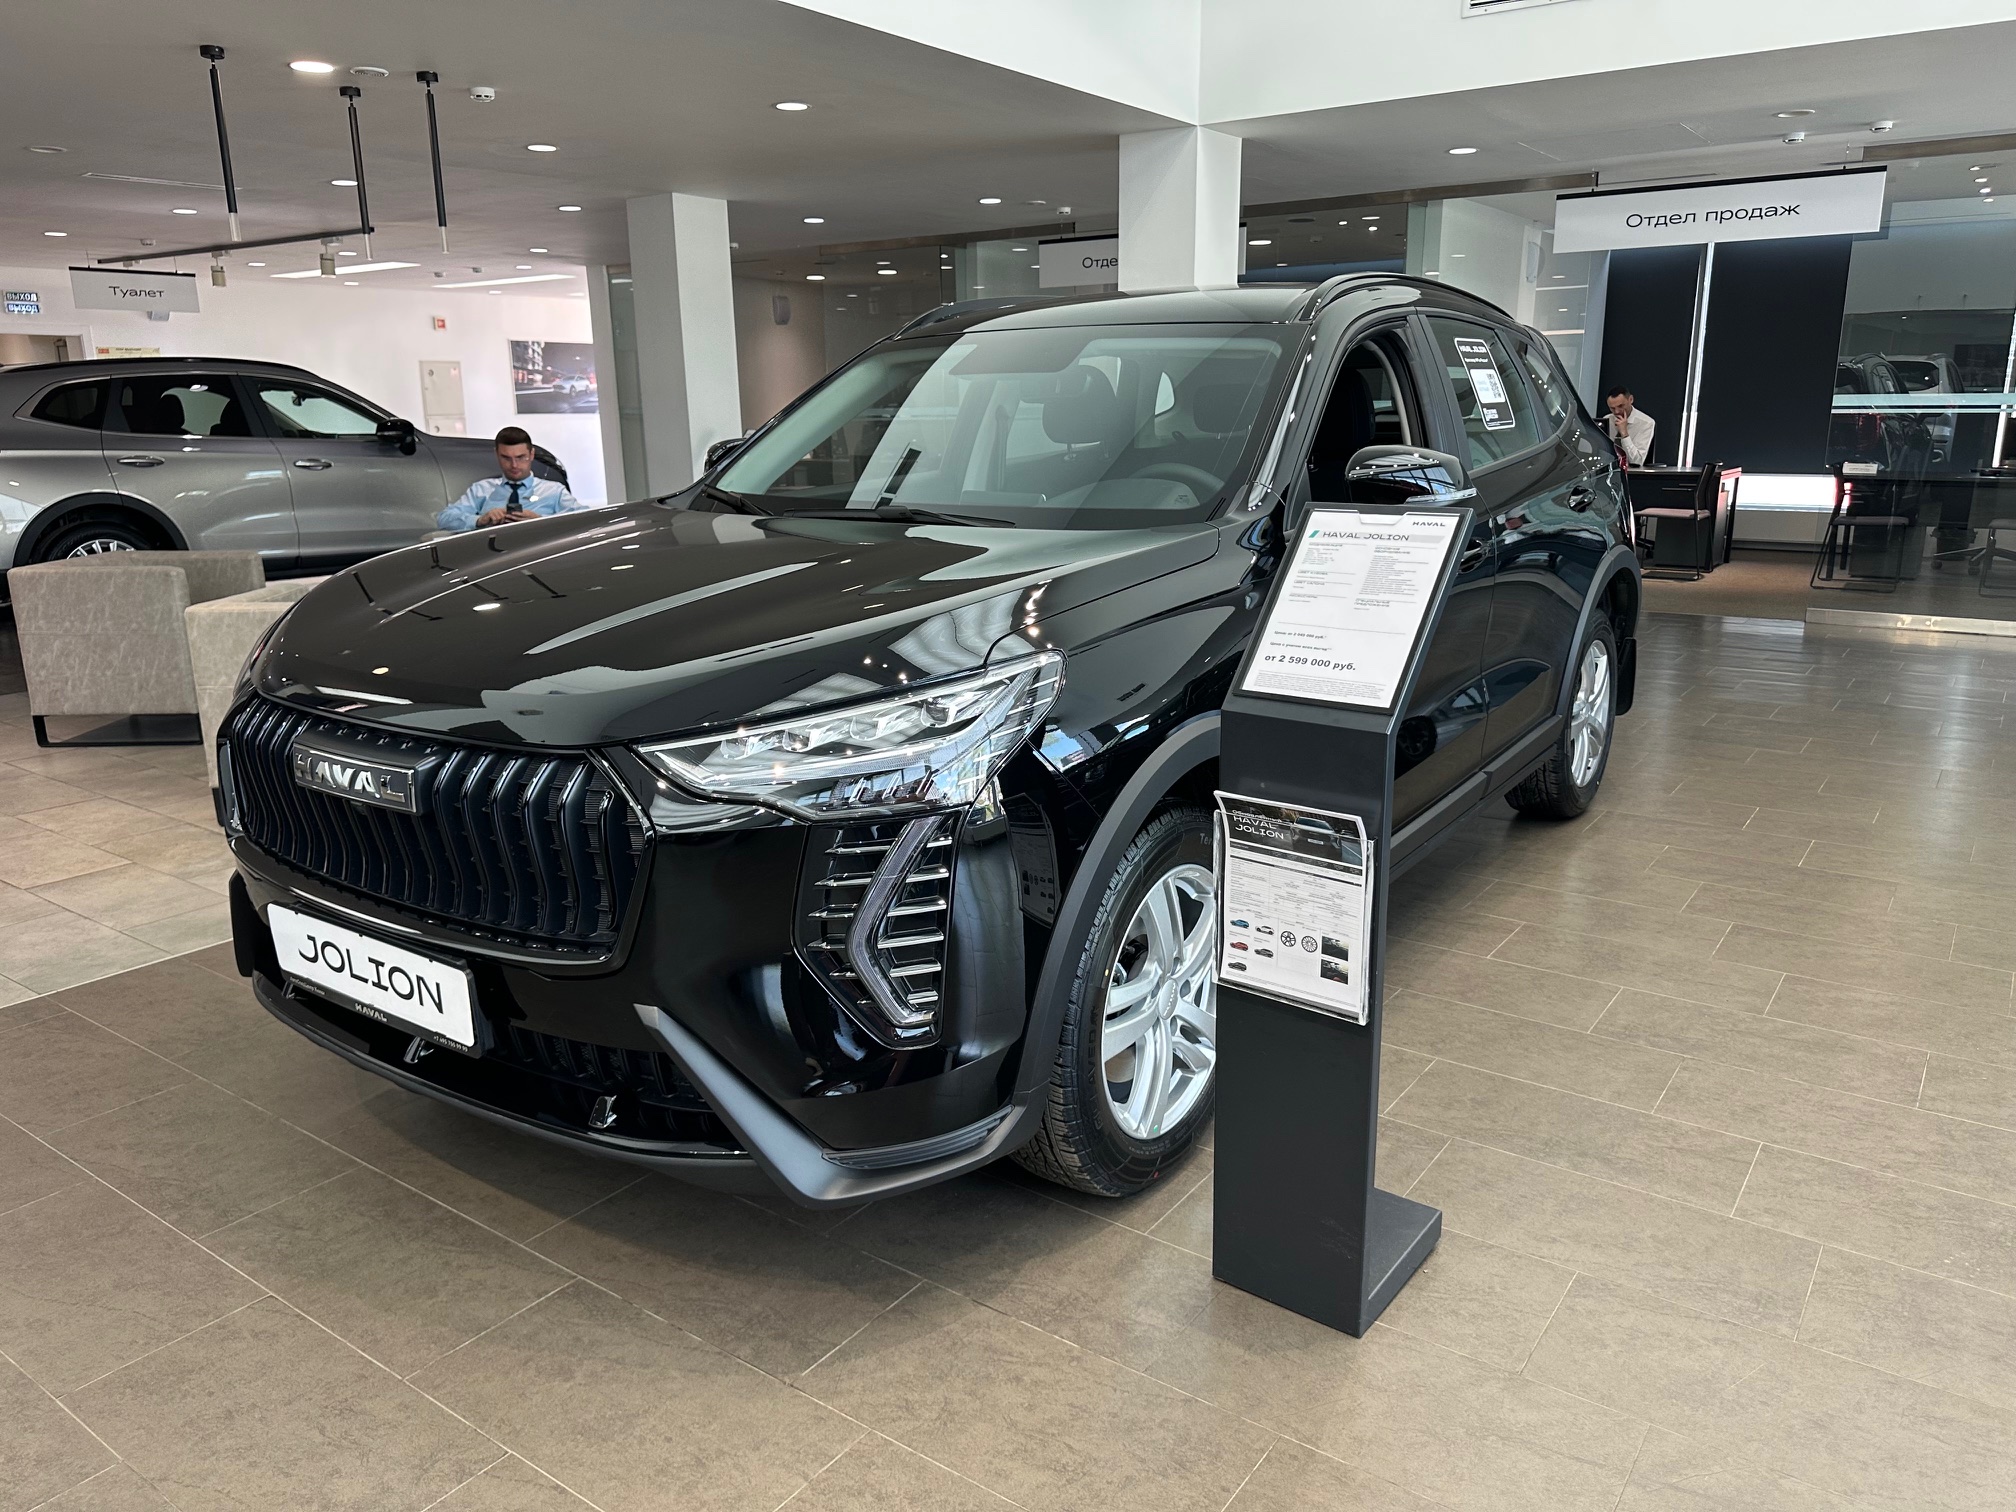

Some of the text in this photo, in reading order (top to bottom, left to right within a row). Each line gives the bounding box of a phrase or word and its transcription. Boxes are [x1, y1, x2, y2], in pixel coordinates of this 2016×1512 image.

[1626, 204, 1801, 228] Отдел продаж
[1082, 256, 1118, 269] Отде
[6, 293, 37, 302] ВЫХОД
[108, 285, 165, 298] Туалет
[1322, 531, 1410, 541] HAVAL JOLION
[1288, 656, 1308, 665] 599
[1310, 658, 1331, 667] 000
[1332, 662, 1356, 671] руб.
[295, 753, 405, 803] HAVAL
[1233, 815, 1277, 829] HAVAL
[1199, 832, 1212, 845] Ter
[1235, 824, 1284, 840] JOLION
[298, 934, 444, 1014] JOLION
[355, 1002, 387, 1022] HAVAL
